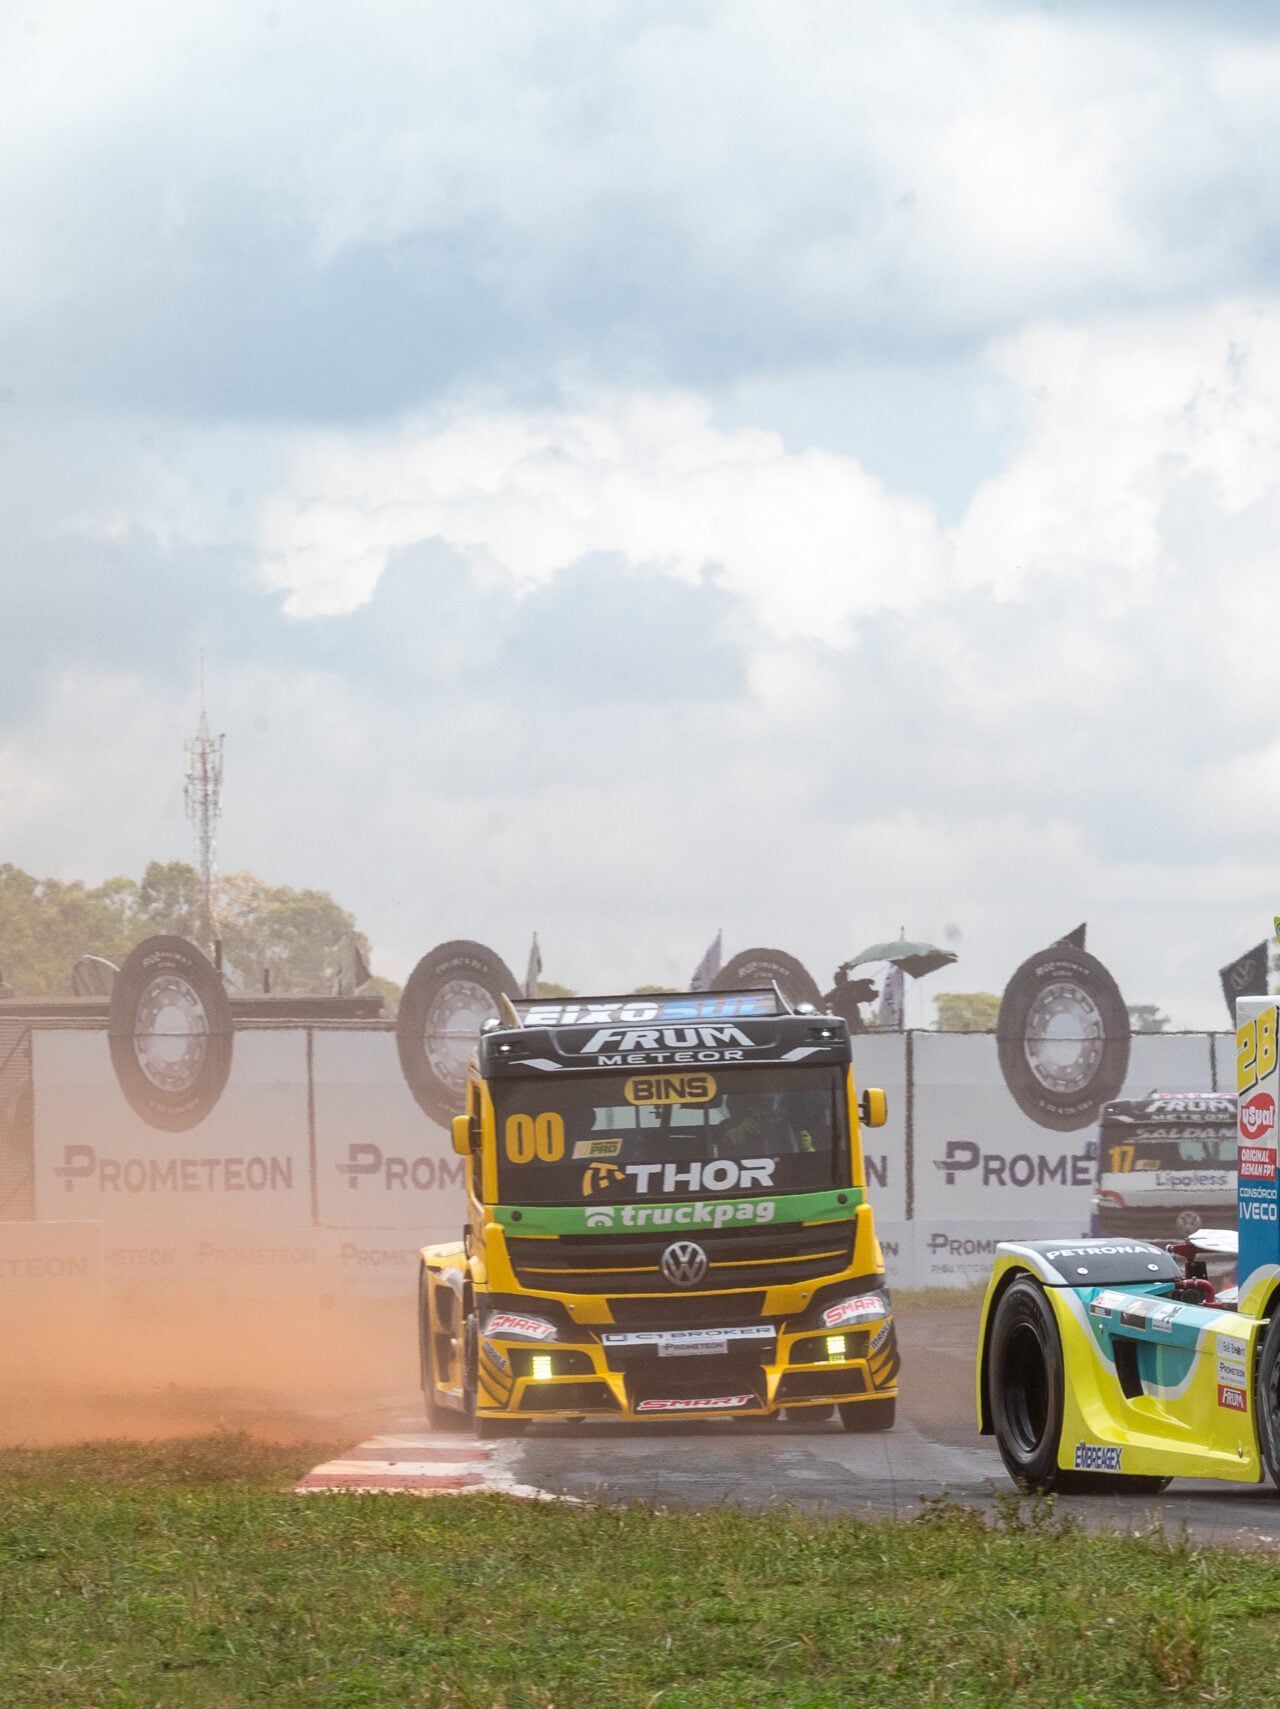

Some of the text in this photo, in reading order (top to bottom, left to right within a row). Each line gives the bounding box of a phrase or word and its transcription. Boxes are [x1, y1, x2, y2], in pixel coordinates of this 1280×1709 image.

[580, 1024, 756, 1053] FRUM
[598, 1050, 744, 1066] METEOR
[1237, 1006, 1280, 1096] 28
[632, 1076, 708, 1100] BINS
[1144, 1100, 1237, 1112] FRUM
[1241, 1106, 1275, 1133] usual
[505, 1112, 565, 1164] 00
[933, 1141, 1097, 1187] PROME
[1108, 1145, 1135, 1173] 17
[1241, 1150, 1270, 1163] ORIGINAL
[53, 1144, 293, 1192] PROMETEON
[625, 1158, 777, 1193] THOR
[1241, 1163, 1275, 1177] REMAN FPT
[1240, 1186, 1277, 1199] CONSÓRCIO
[620, 1201, 776, 1228] truckpag
[1239, 1203, 1277, 1220] IVECO
[1046, 1246, 1162, 1260] PETRONAS
[487, 1315, 555, 1335] SMART
[640, 1396, 751, 1410] SMART
[1222, 1388, 1244, 1408] FRUM
